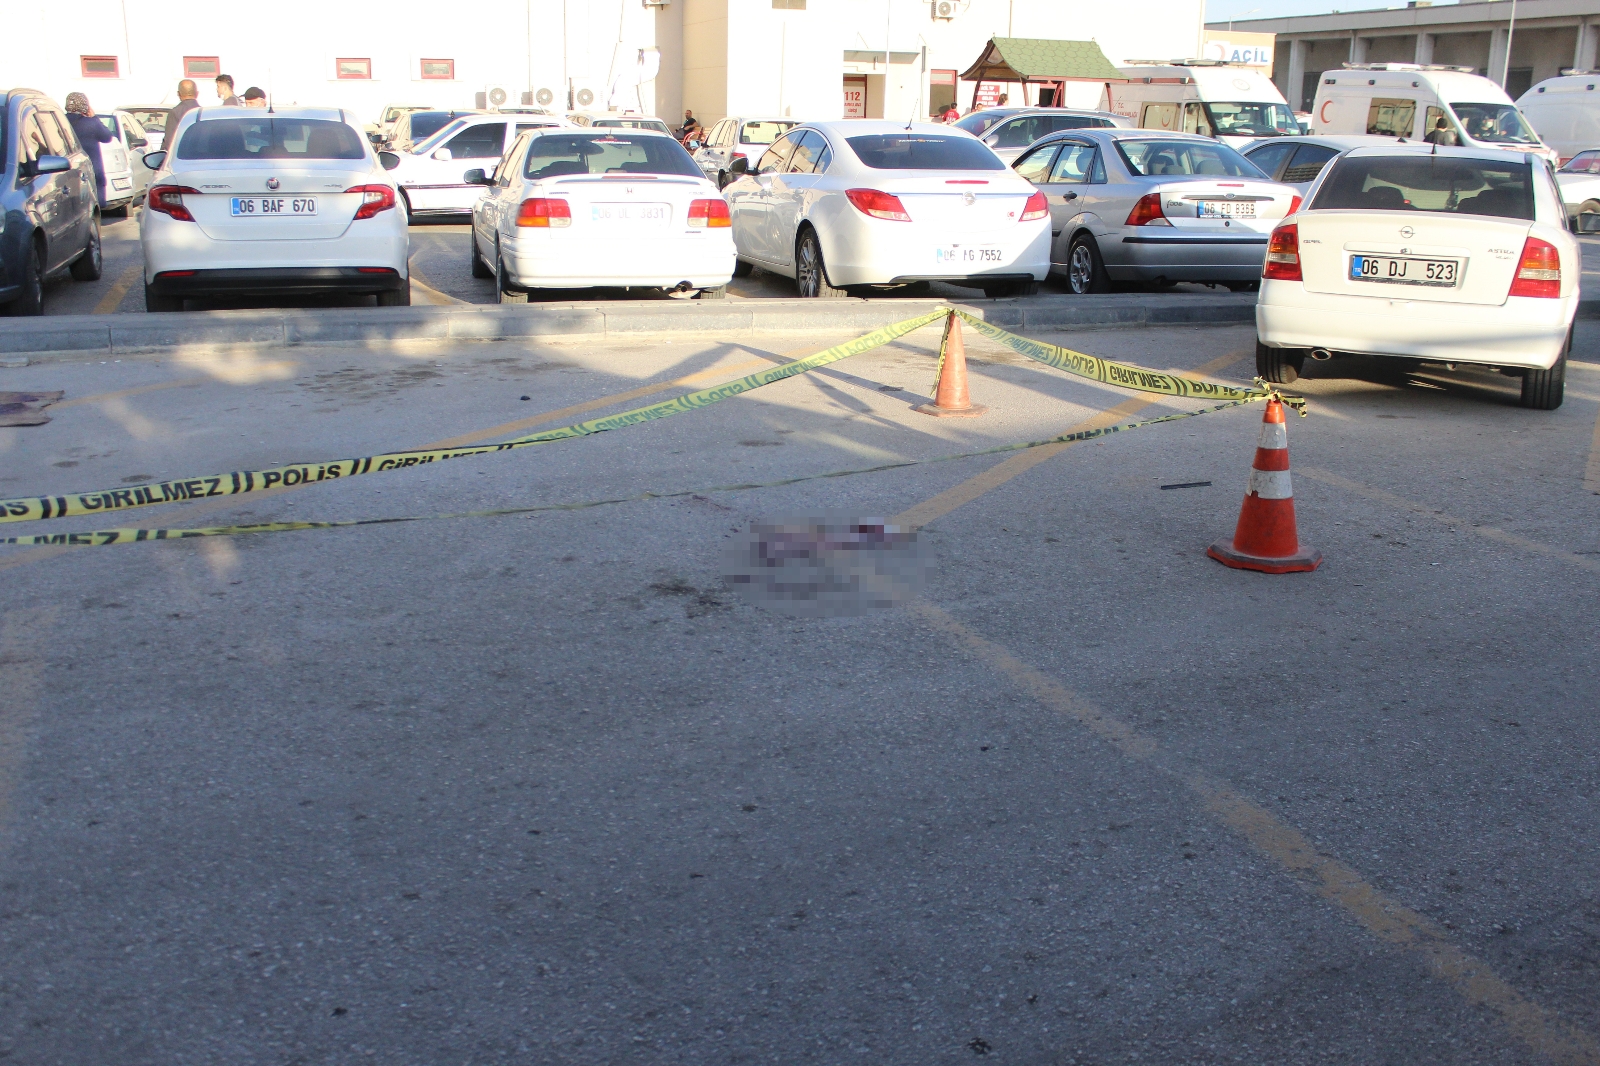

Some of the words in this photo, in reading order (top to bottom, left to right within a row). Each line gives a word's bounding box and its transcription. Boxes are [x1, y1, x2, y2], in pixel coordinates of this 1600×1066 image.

[844, 91, 861, 101] 112
[239, 200, 255, 213] 06
[262, 200, 285, 213] BAF
[293, 199, 315, 213] 670
[1204, 203, 1216, 214] 06
[979, 249, 1002, 261] 7552
[1362, 259, 1379, 275] 06
[1388, 260, 1407, 277] DJ
[1426, 263, 1454, 280] 523
